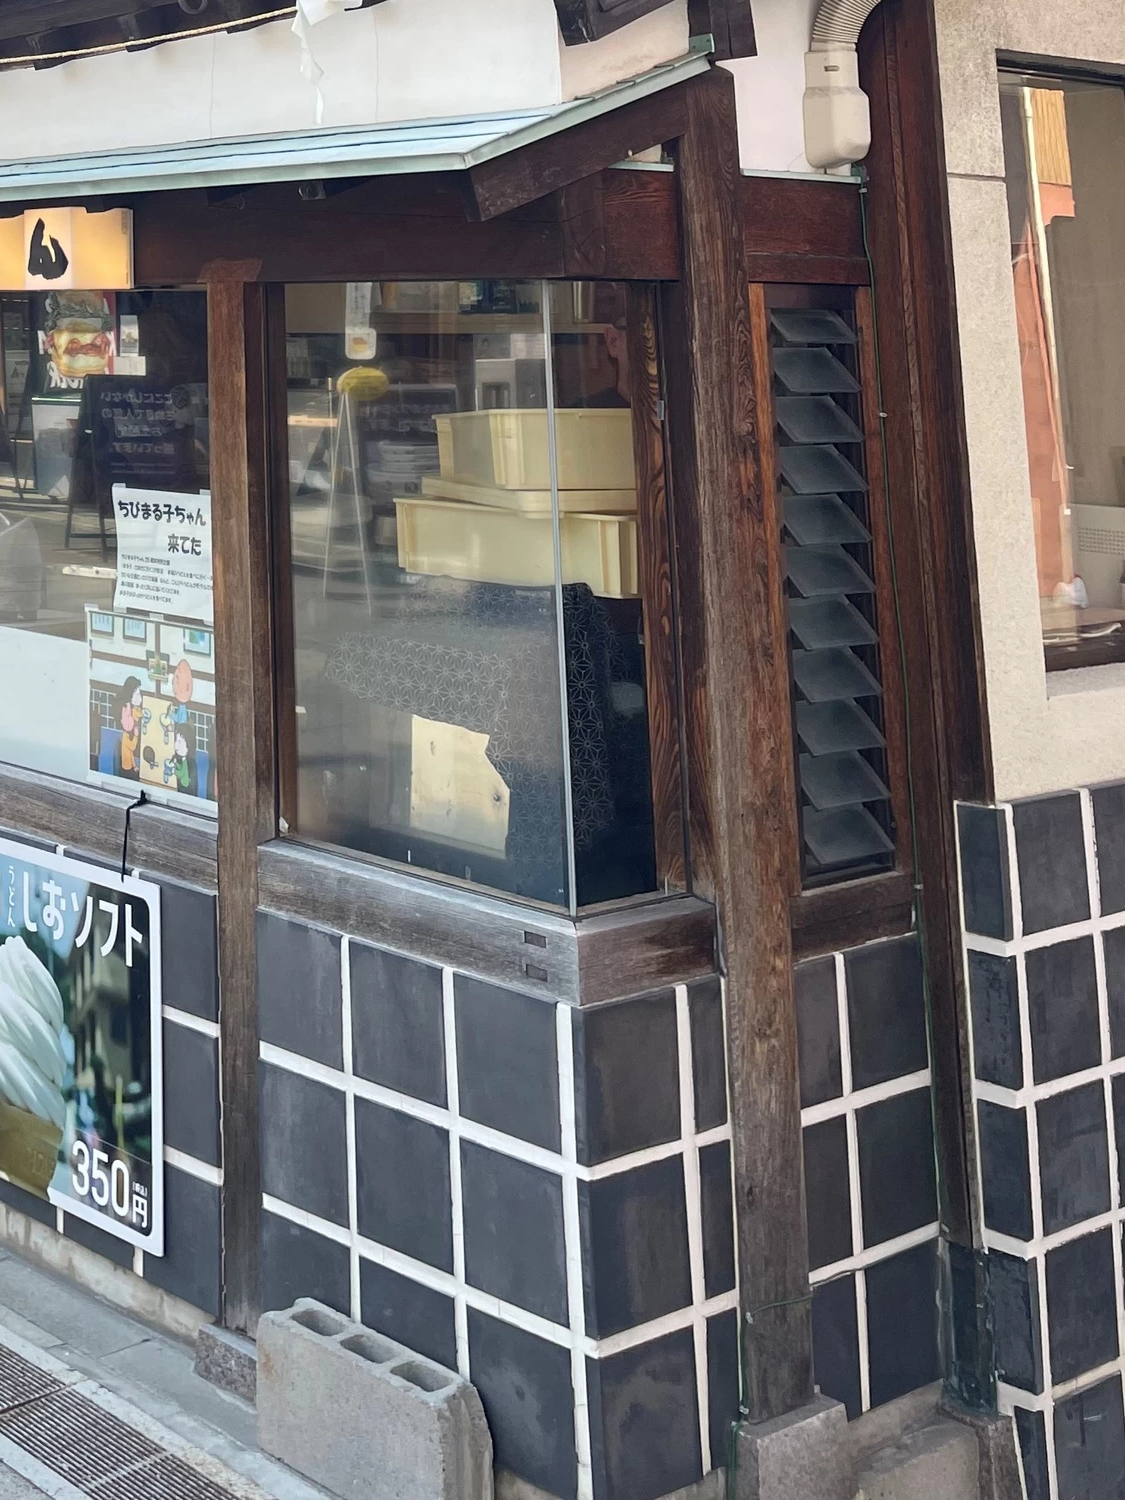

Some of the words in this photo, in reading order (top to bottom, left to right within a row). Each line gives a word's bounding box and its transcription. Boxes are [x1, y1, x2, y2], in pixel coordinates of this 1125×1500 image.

[117, 499, 207, 527] ちびまる子ちゃん
[167, 533, 202, 556] 来てた
[72, 1139, 148, 1229] 350円
